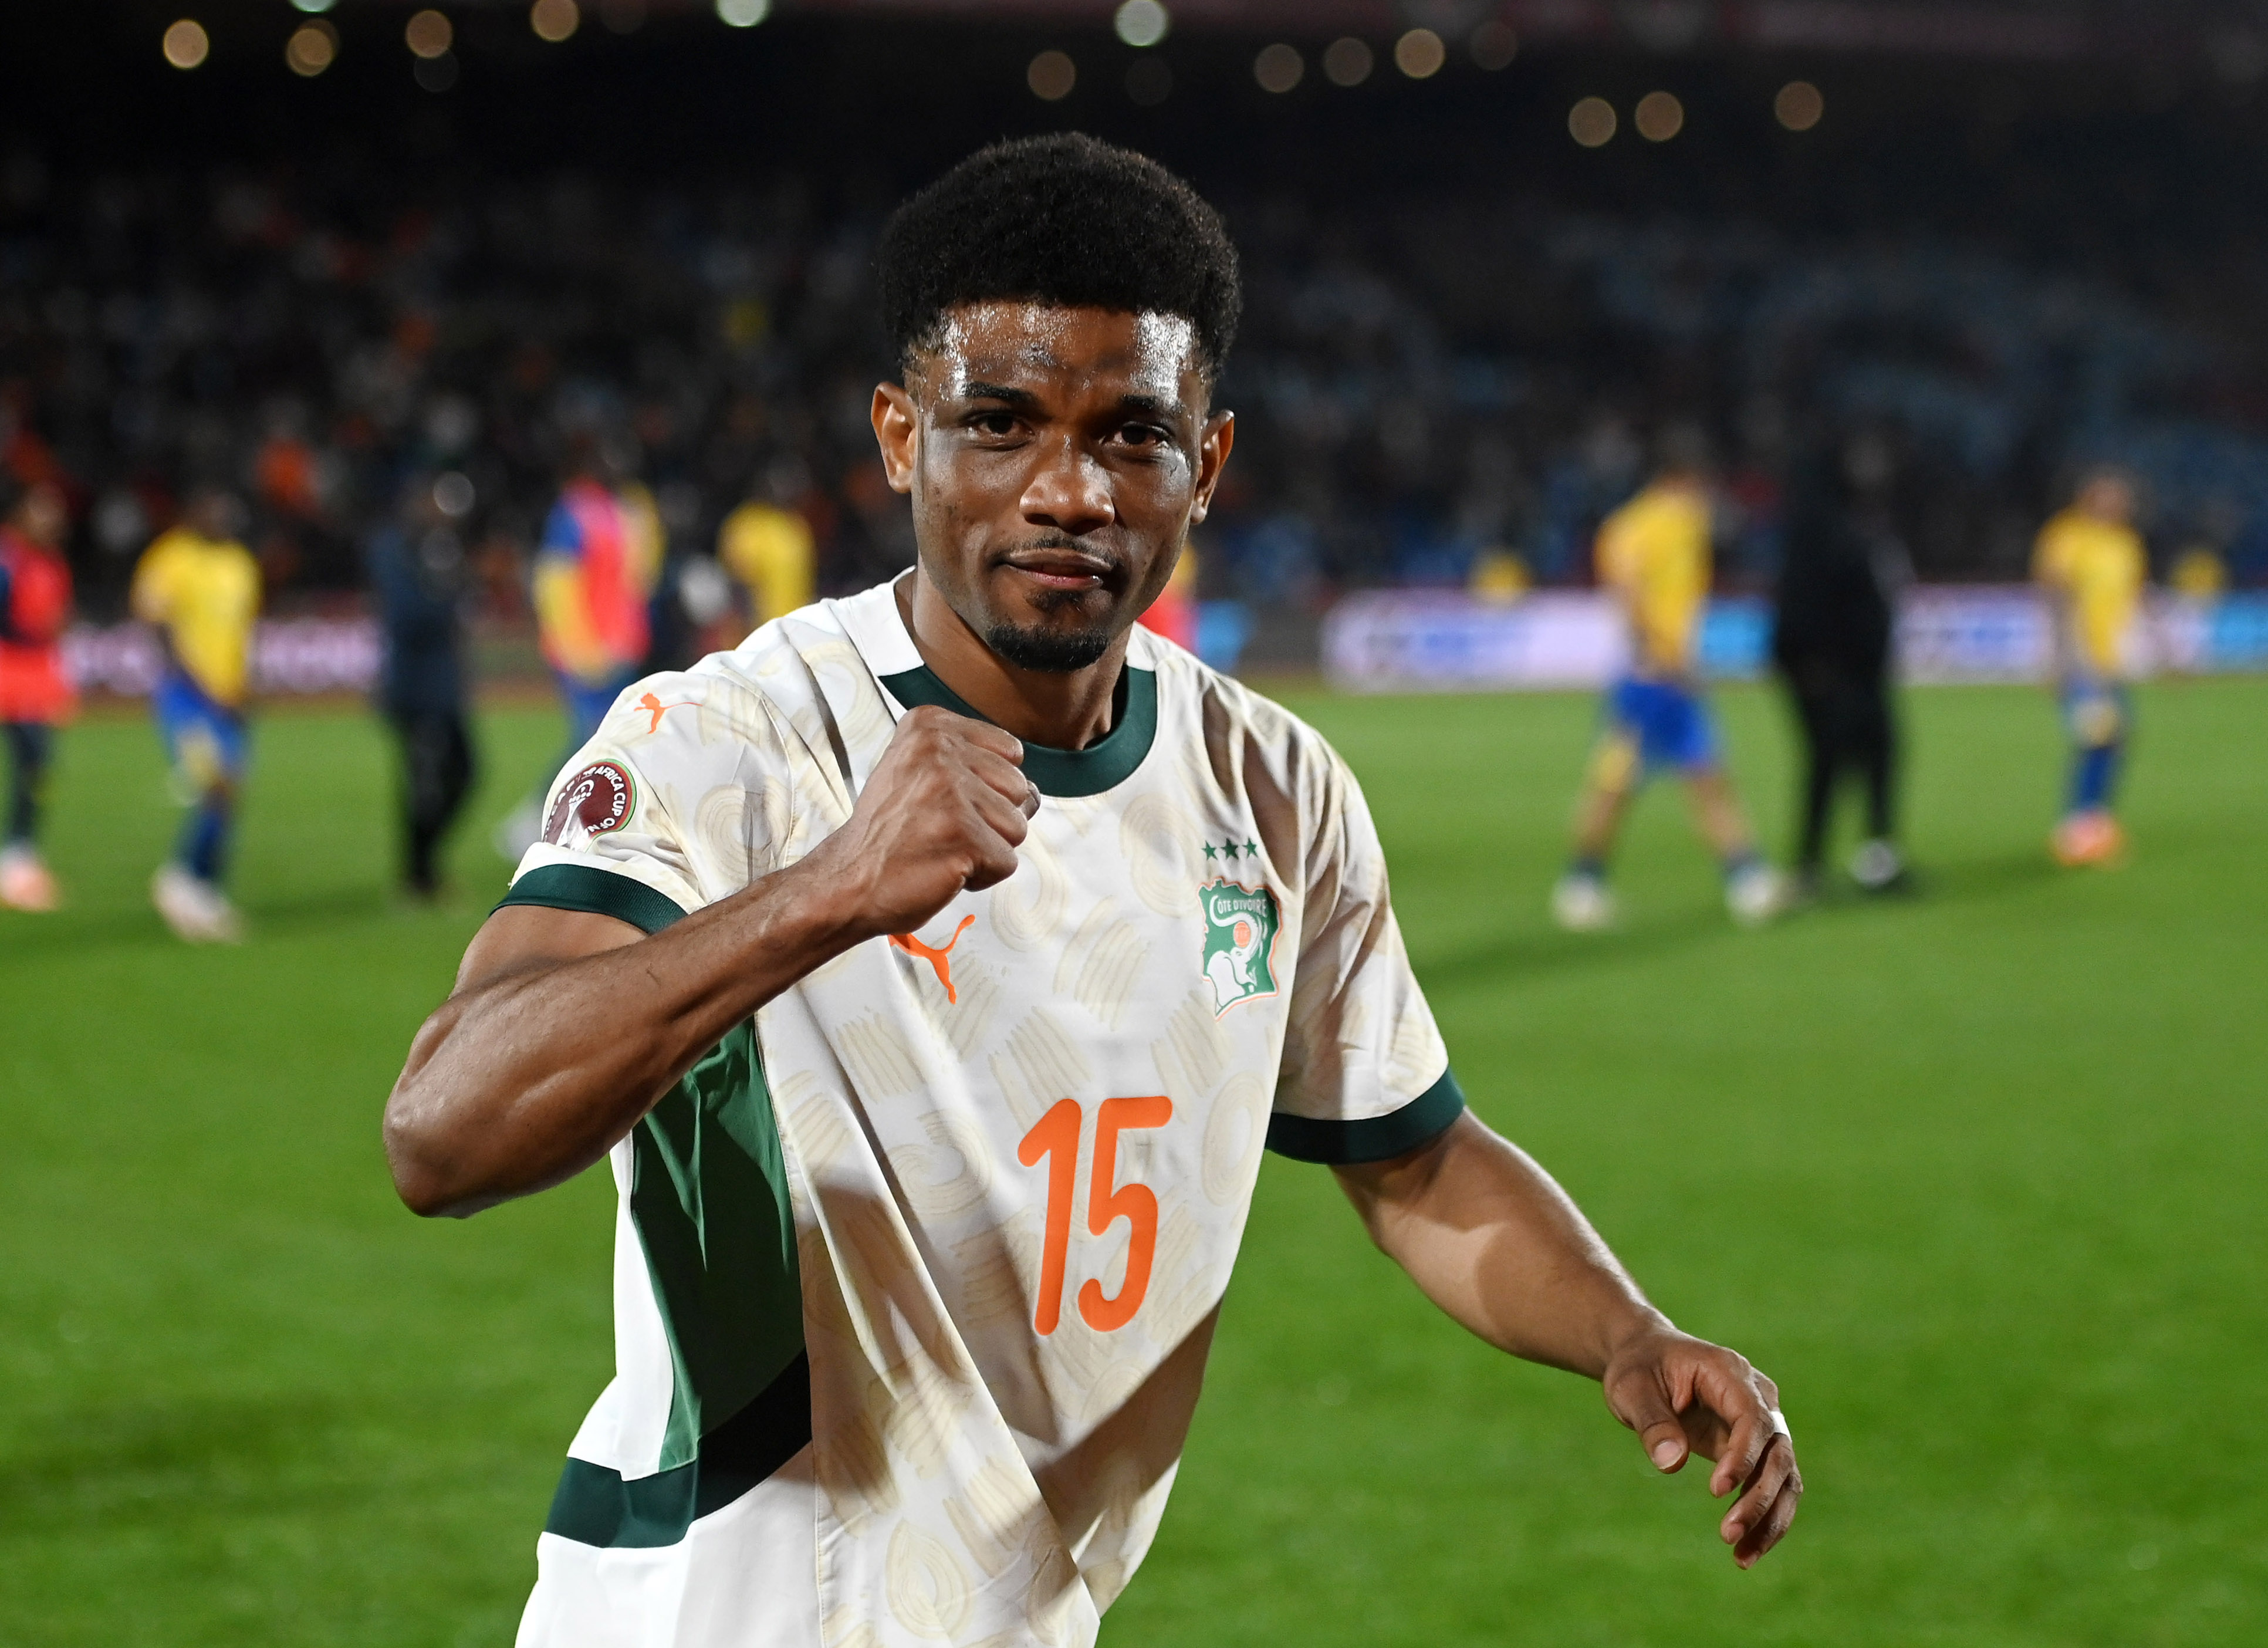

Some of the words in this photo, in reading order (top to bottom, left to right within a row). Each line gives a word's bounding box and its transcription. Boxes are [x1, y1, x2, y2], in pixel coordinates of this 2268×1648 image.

[595, 766, 624, 792] AFRICA
[611, 793, 626, 816] CUP
[1018, 1096, 1172, 1335] 15
